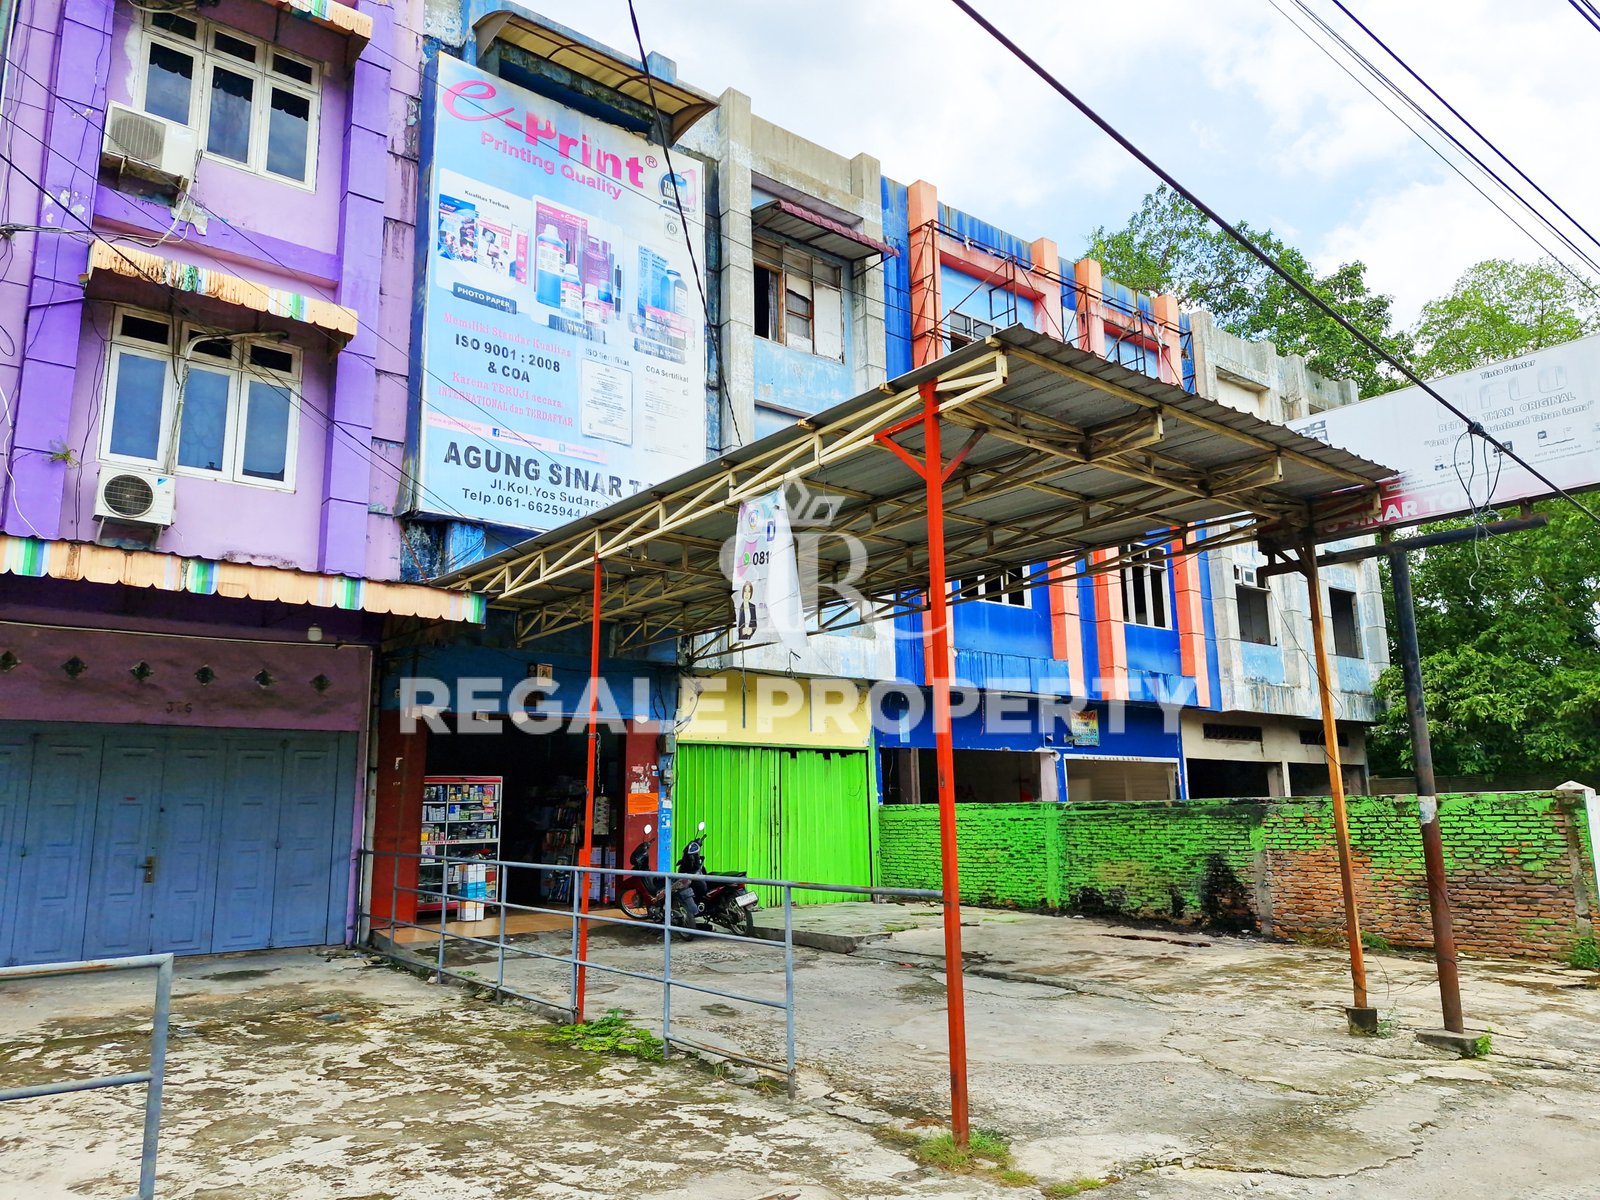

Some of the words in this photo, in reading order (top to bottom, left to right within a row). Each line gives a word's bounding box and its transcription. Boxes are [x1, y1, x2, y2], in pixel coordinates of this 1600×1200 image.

[443, 80, 644, 188] e-Print
[481, 131, 555, 174] Printing
[561, 164, 622, 200] Quality
[457, 286, 485, 300] PHOTO
[485, 295, 511, 308] PAPER
[443, 312, 490, 334] Memiliki
[491, 326, 530, 346] Standar
[532, 338, 572, 358] Kualitas
[455, 332, 480, 351] ISO
[484, 341, 517, 362] 9001
[528, 354, 561, 373] 2008
[487, 361, 498, 374] &
[501, 364, 531, 383] COA
[645, 365, 661, 375] COA
[661, 370, 689, 383] Sertifikat
[1503, 359, 1536, 374] Printer
[438, 386, 508, 411] INTERNATIONAL
[509, 402, 524, 415] dan
[526, 408, 573, 427] TERDAFTAR
[452, 372, 490, 389] Karena
[491, 380, 529, 399] TERUJI
[532, 394, 562, 408] secara
[1483, 406, 1514, 422] THAN
[1520, 391, 1577, 412] ORIGINAL
[1484, 416, 1530, 433] Printhead
[1531, 409, 1561, 424] Tahan
[443, 441, 541, 481] AGUNG
[548, 462, 623, 498] SINAR
